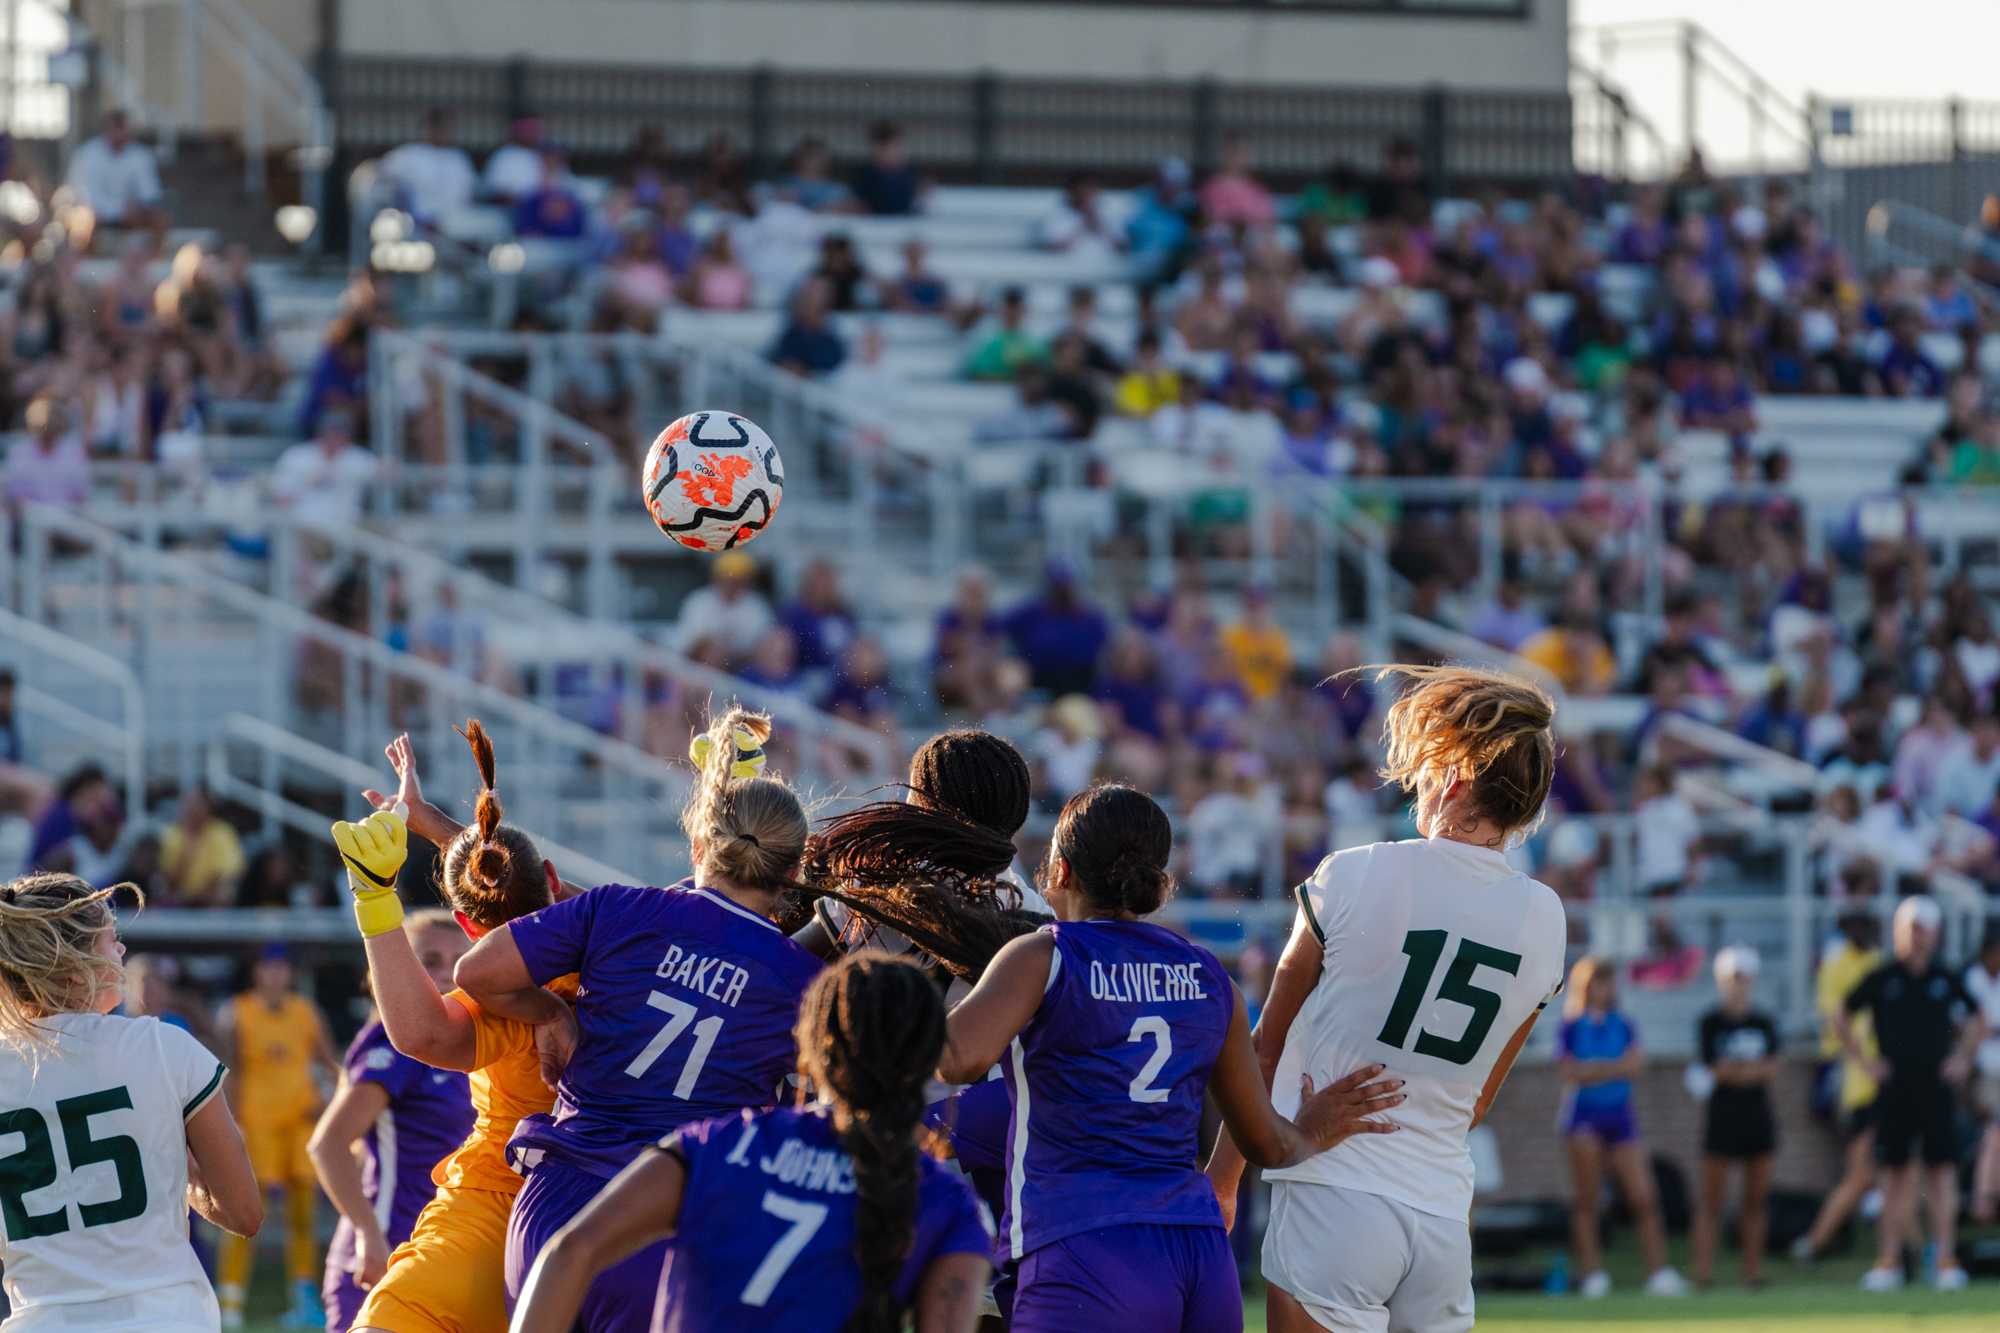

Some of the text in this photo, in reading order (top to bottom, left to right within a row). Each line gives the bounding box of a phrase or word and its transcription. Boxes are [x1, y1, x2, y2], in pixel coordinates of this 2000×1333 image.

[655, 943, 749, 1008] BAKER
[1090, 960, 1207, 1002] OLLIVIERRE
[1376, 929, 1522, 1065] 15
[624, 989, 725, 1101] 71
[1127, 1016, 1172, 1102] 2
[0, 1085, 148, 1242] 25
[740, 1189, 830, 1308] 7
